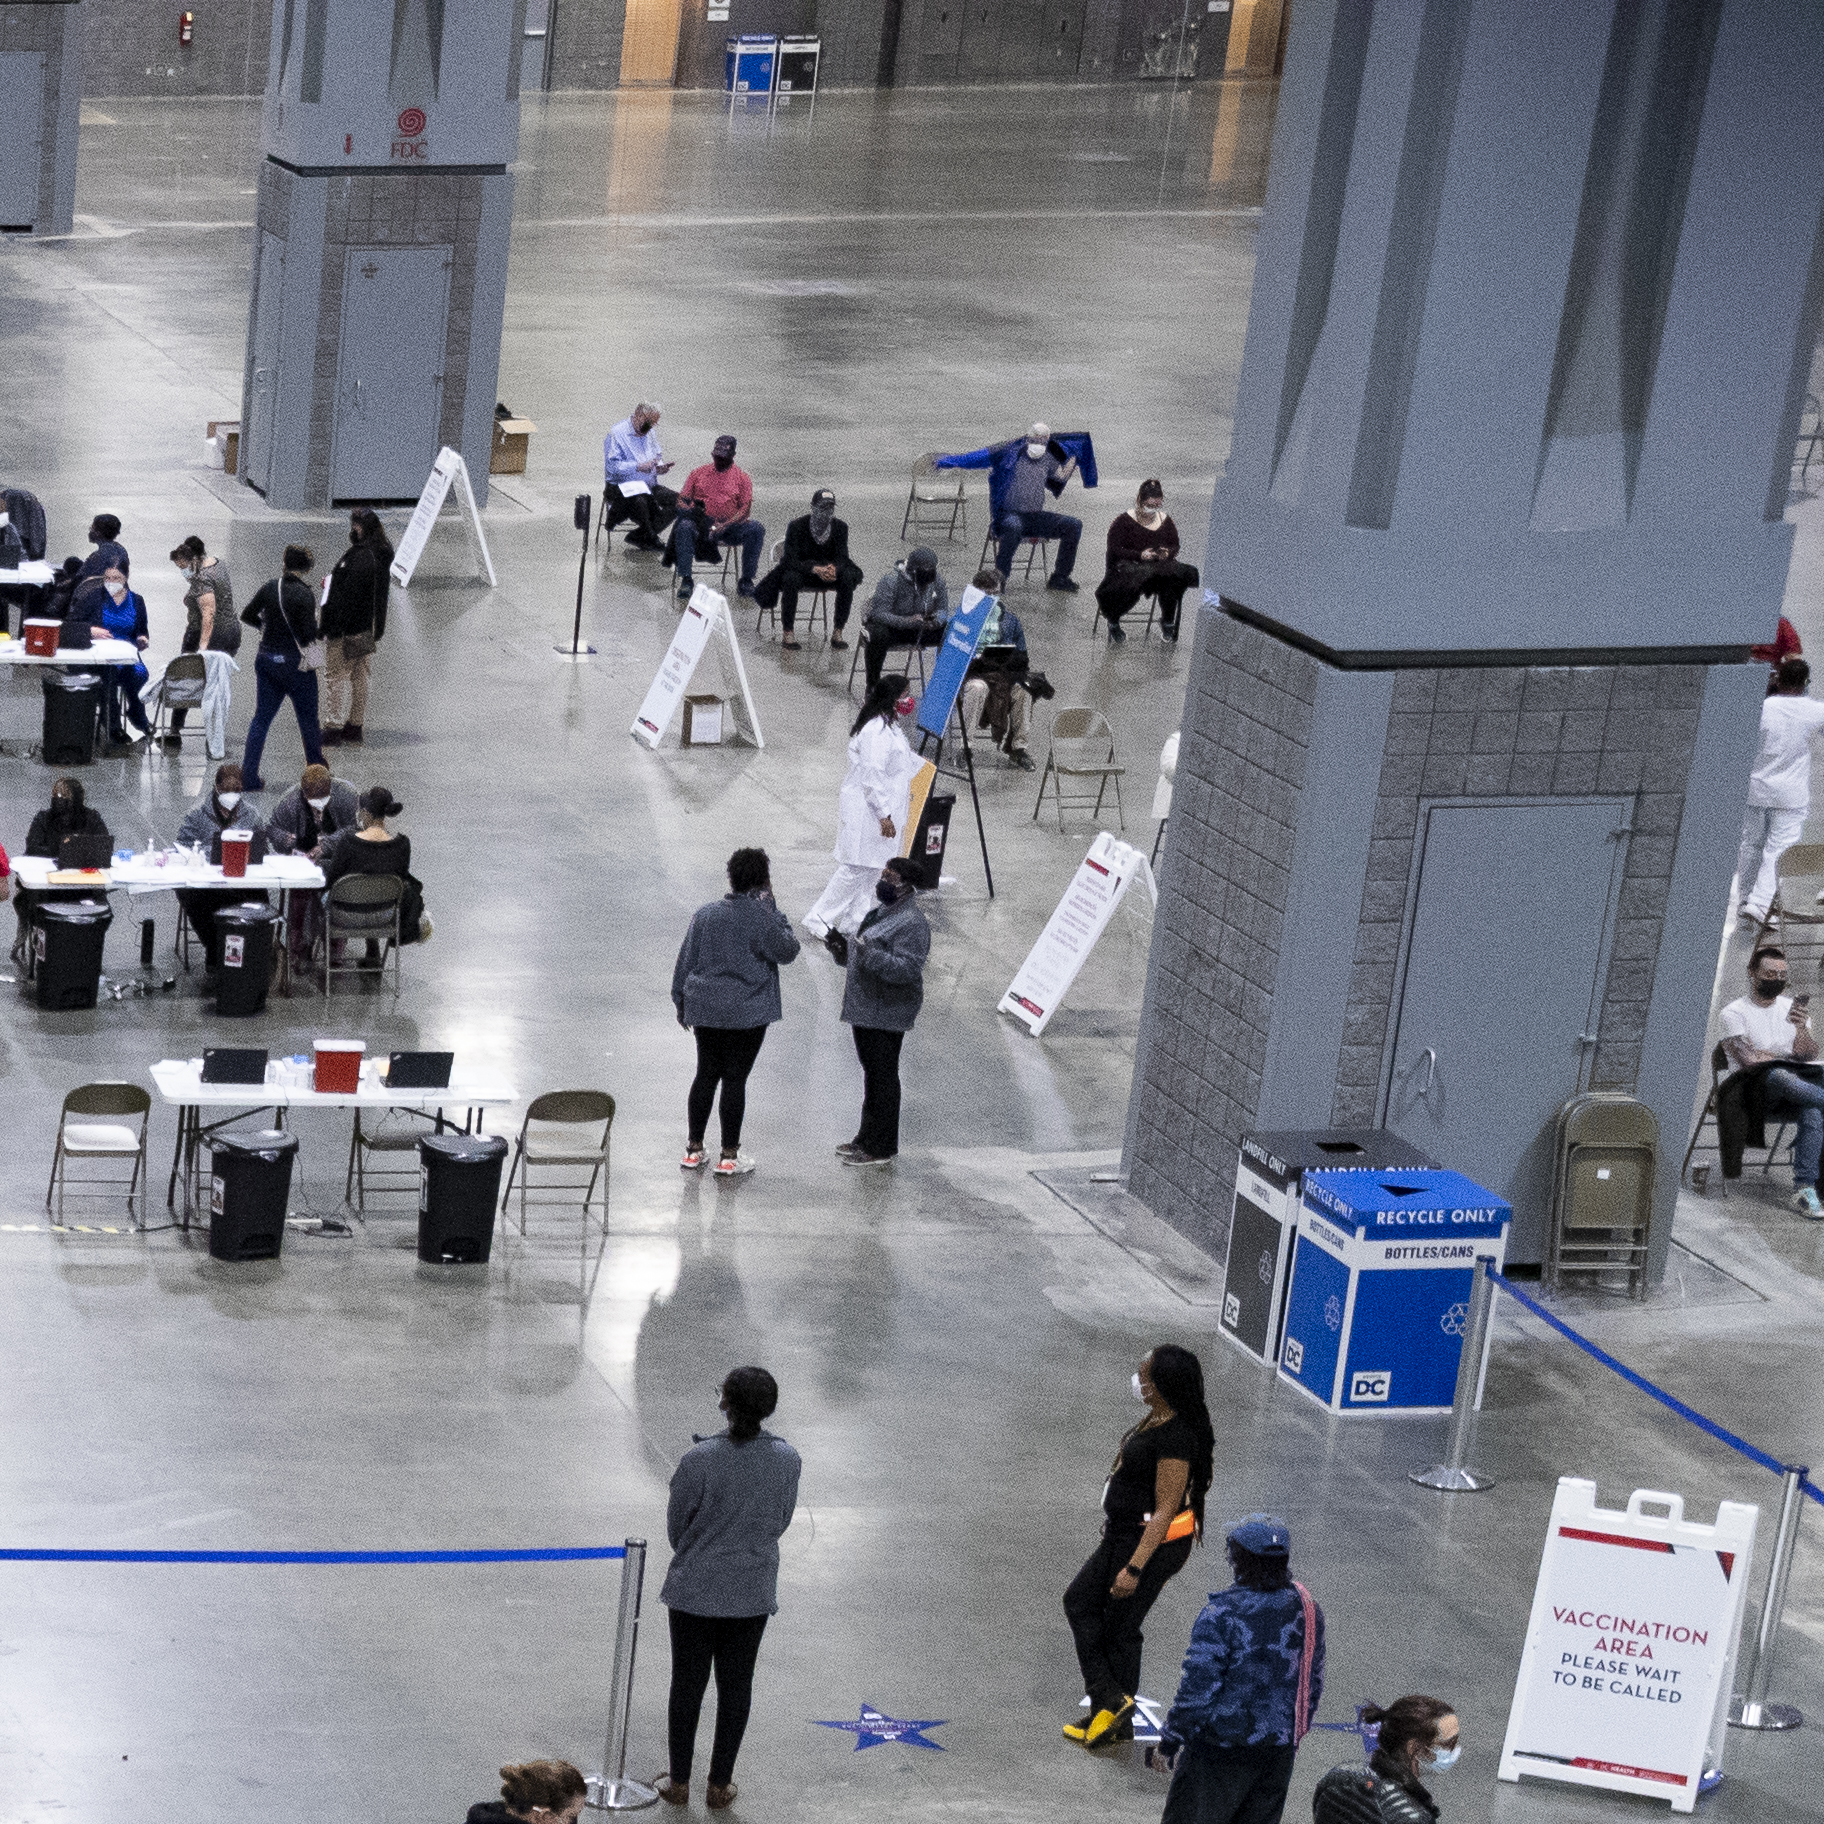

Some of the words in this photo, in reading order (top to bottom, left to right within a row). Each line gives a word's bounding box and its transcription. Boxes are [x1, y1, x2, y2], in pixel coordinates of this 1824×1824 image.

[391, 141, 428, 158] FDC
[1242, 1138, 1267, 1168] LANDFILL
[1268, 1153, 1286, 1174] ONLY
[1305, 1179, 1332, 1206] RECYCLE
[1334, 1196, 1353, 1218] ONLY
[1376, 1209, 1444, 1225] RECYCLE
[1451, 1208, 1497, 1223] ONLY
[1384, 1246, 1474, 1260] BOTTLES/CANS
[1287, 1348, 1301, 1368] DC
[1354, 1379, 1386, 1396] DC
[1553, 1606, 1709, 1645] VACCINATION
[1593, 1637, 1653, 1659] AREA
[1560, 1653, 1628, 1676] PLEASE
[1635, 1664, 1681, 1683] WAIT
[1553, 1670, 1577, 1687] TO
[1582, 1675, 1603, 1691] BE
[1610, 1681, 1682, 1704] CALLED
